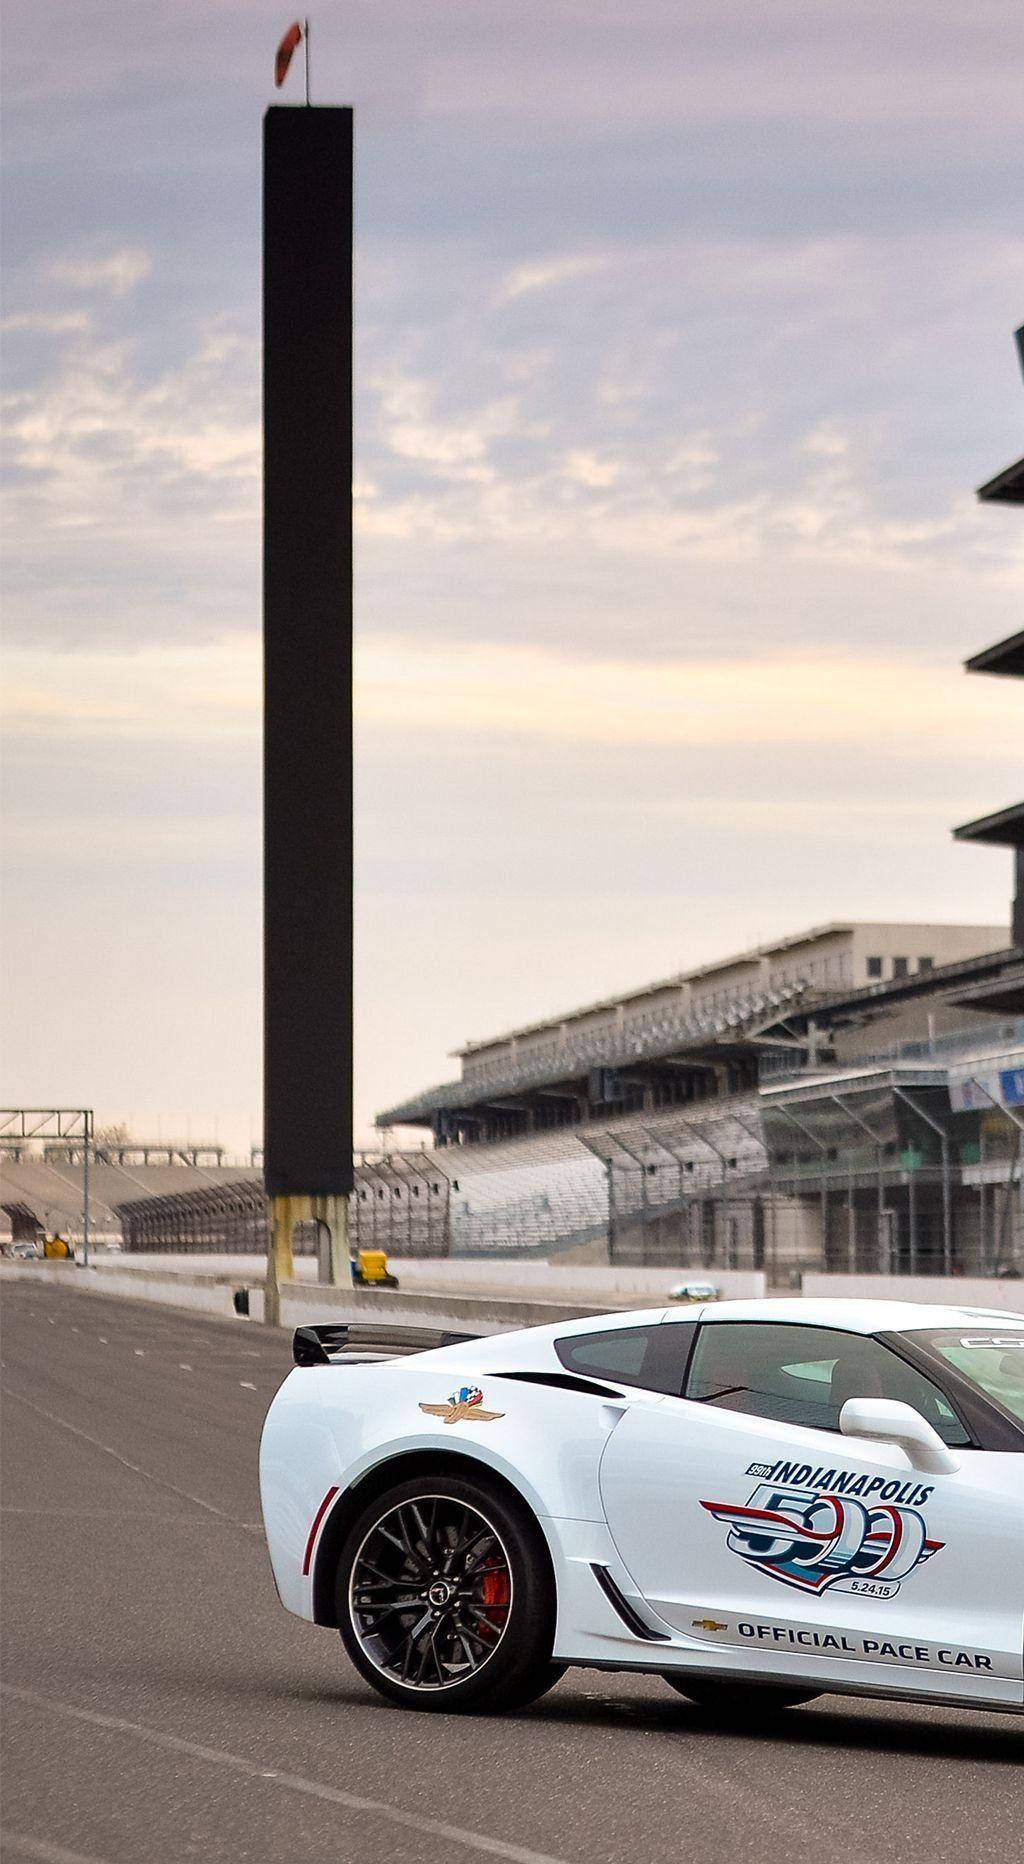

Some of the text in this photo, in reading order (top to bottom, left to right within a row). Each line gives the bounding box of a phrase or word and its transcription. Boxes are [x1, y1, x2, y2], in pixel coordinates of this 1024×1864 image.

[749, 1460, 935, 1506] 99th INDIANAPOLIS
[727, 1484, 926, 1581] 500
[850, 1581, 891, 1597] 5.24.15
[737, 1622, 995, 1671] OFFICIAL PACE CAR
